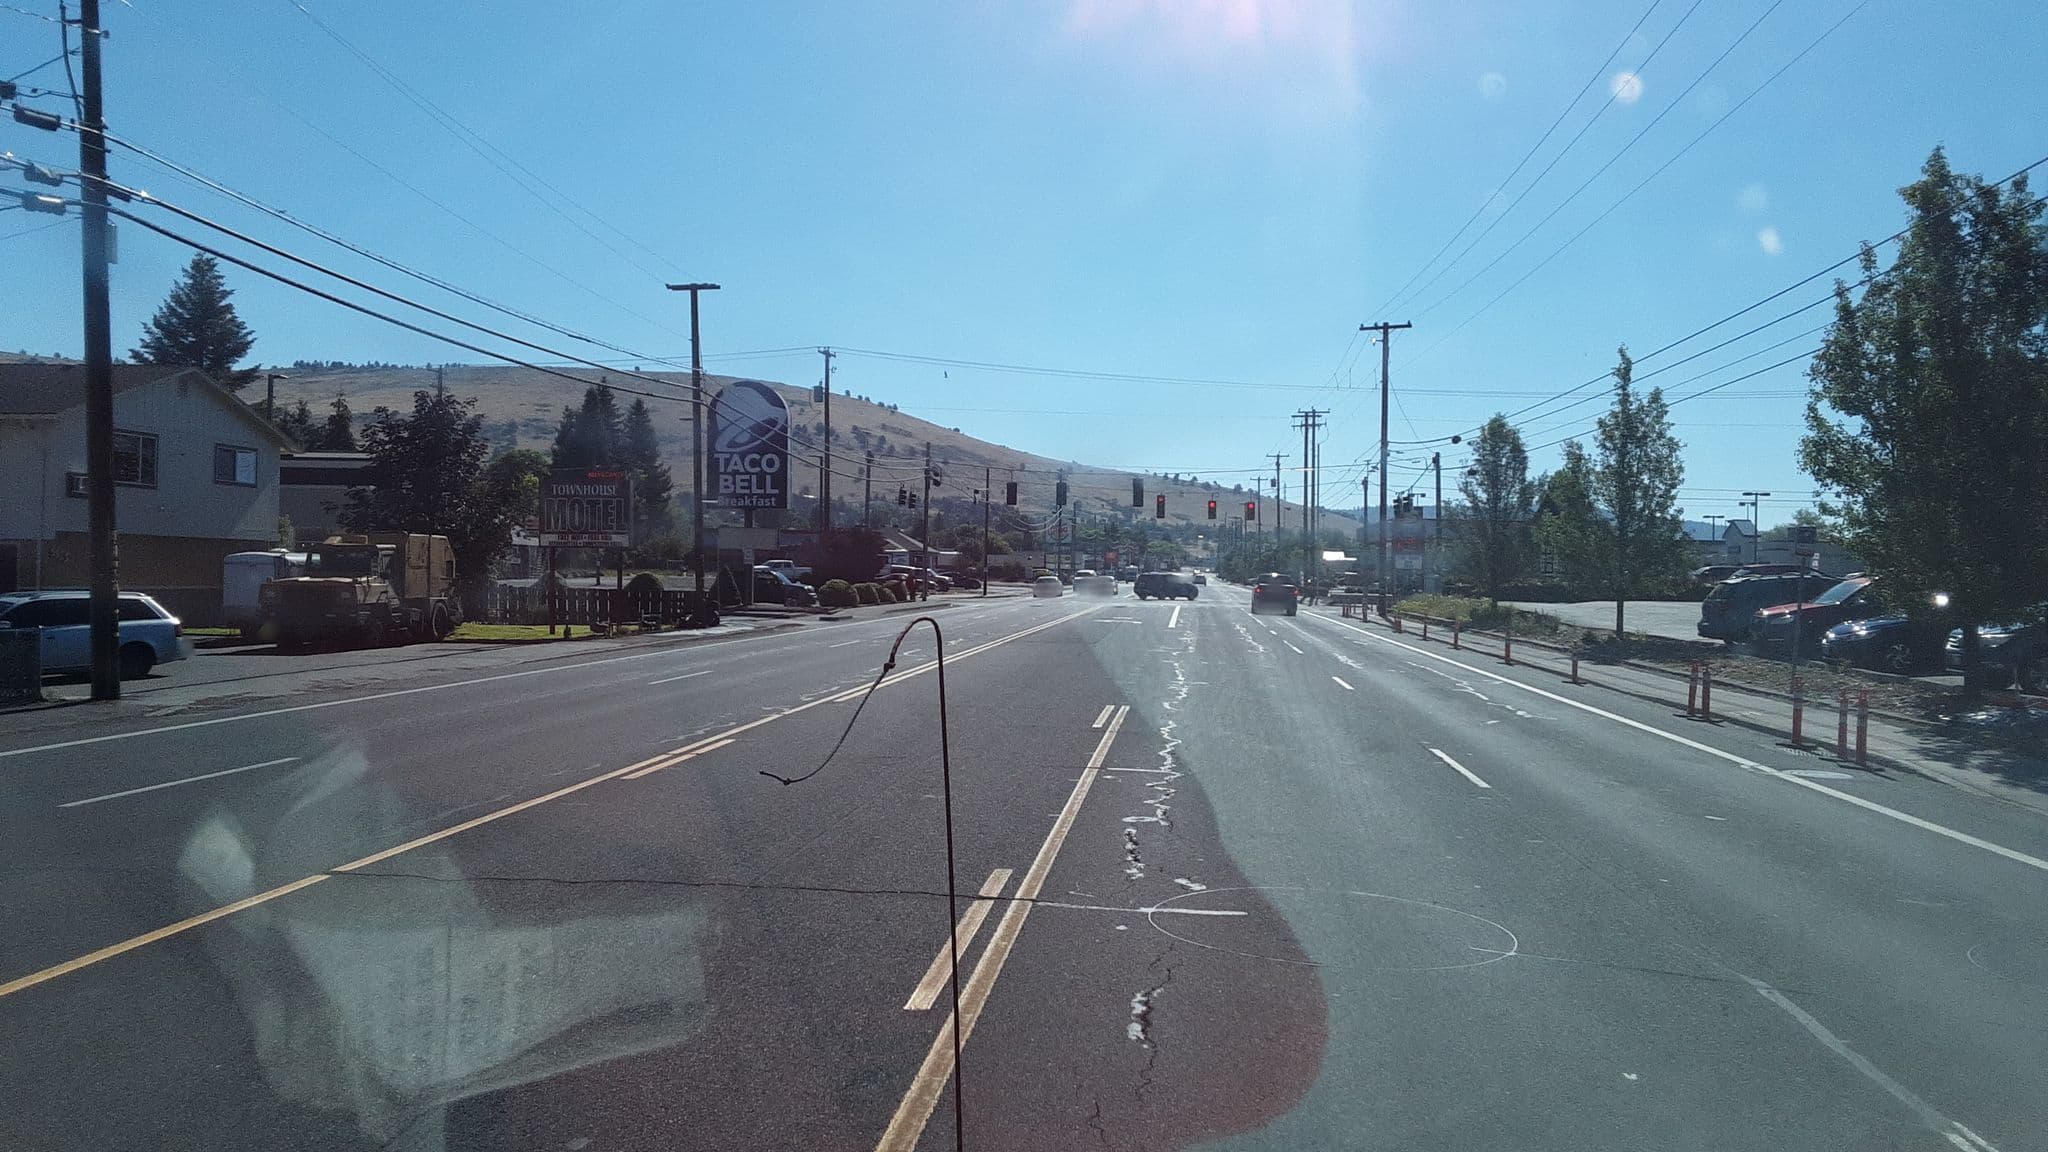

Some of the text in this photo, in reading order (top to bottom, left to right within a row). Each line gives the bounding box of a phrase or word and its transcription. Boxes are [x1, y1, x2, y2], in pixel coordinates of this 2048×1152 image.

[714, 453, 780, 473] TACO
[551, 484, 617, 496] TOWNHOUSE
[719, 474, 779, 494] BELL
[717, 495, 777, 506] Breakfast
[544, 497, 628, 532] MOTEL
